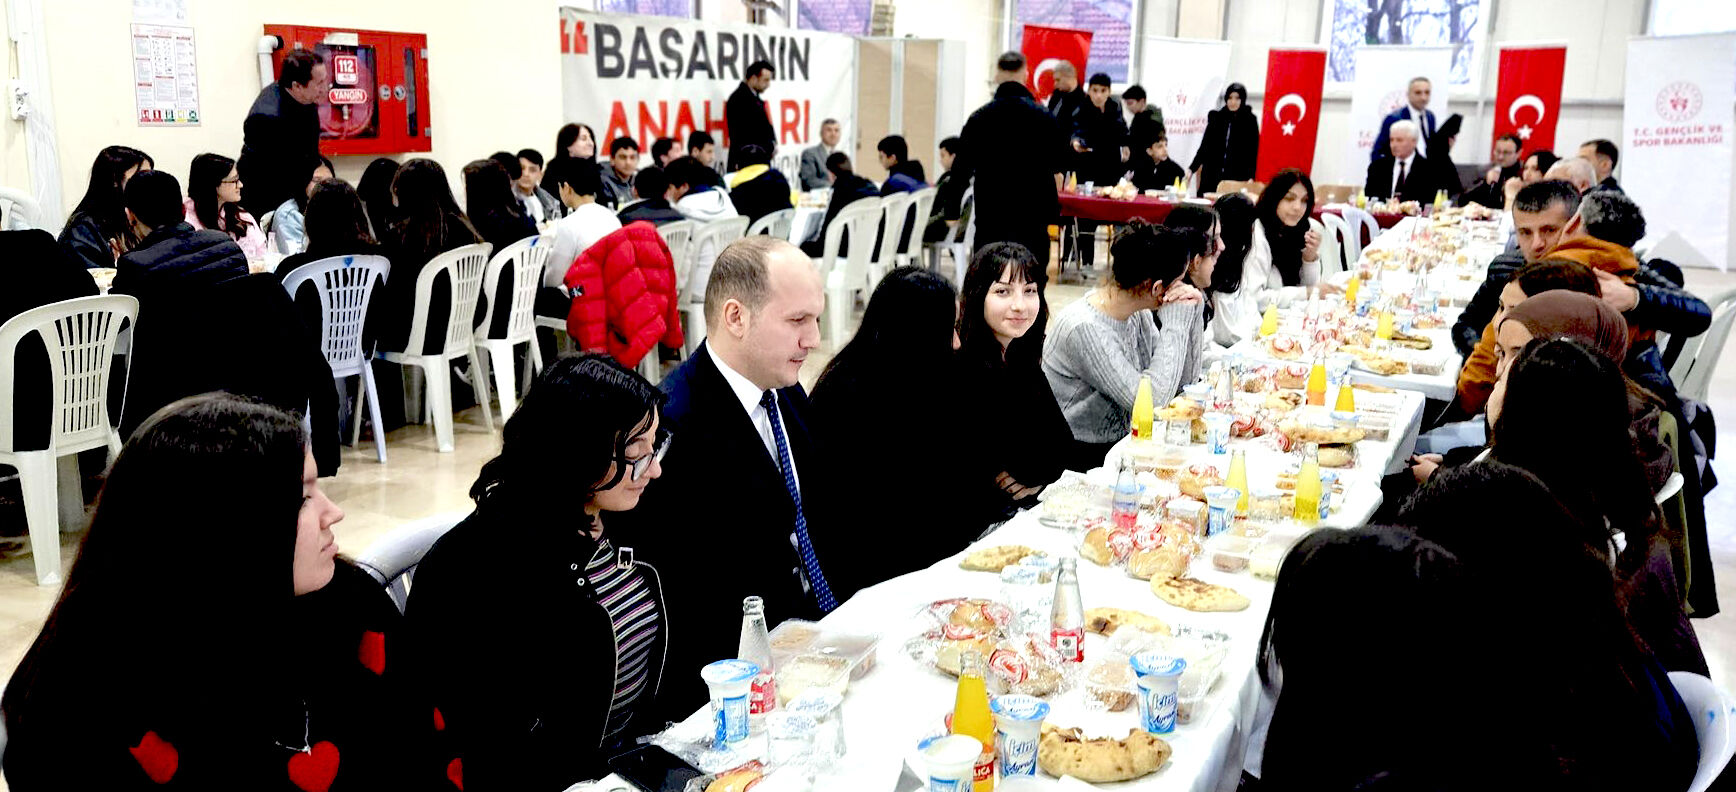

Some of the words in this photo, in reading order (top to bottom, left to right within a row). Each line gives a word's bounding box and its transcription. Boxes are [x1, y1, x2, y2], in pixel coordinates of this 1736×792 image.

[338, 59, 355, 73] 112
[600, 100, 809, 156] ANAHRI
[1634, 127, 1652, 137] T.C.
[1655, 124, 1704, 138] GENÇLİK
[1708, 124, 1722, 133] VE
[1632, 138, 1661, 148] SPOR
[1663, 135, 1722, 146] BAKANLIĞI
